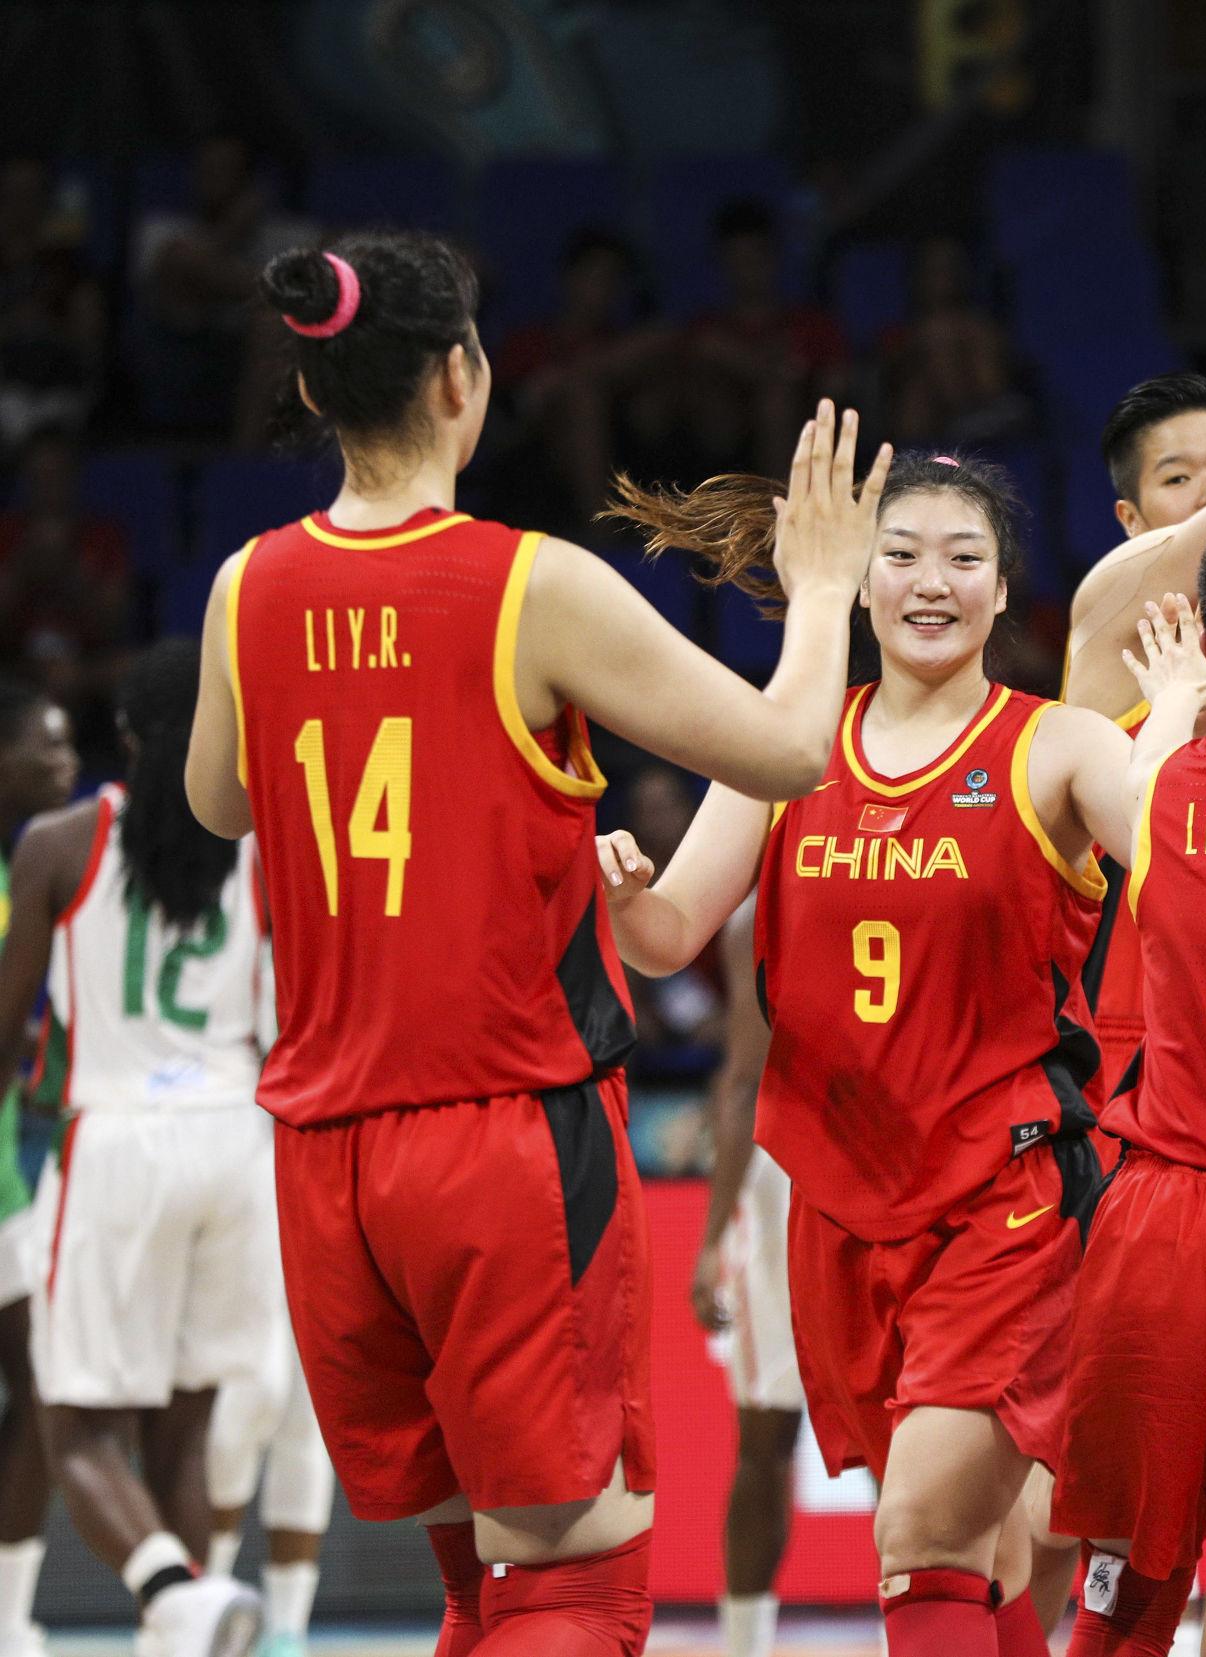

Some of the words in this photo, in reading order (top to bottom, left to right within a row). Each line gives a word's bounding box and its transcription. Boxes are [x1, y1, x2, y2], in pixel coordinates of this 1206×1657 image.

[305, 608, 336, 672] LI
[347, 606, 412, 670] Y.R.
[294, 717, 412, 917] 14
[795, 835, 969, 880] CHINA
[123, 893, 228, 1031] 12
[852, 920, 901, 1024] 9
[1019, 1125, 1040, 1140] 54
